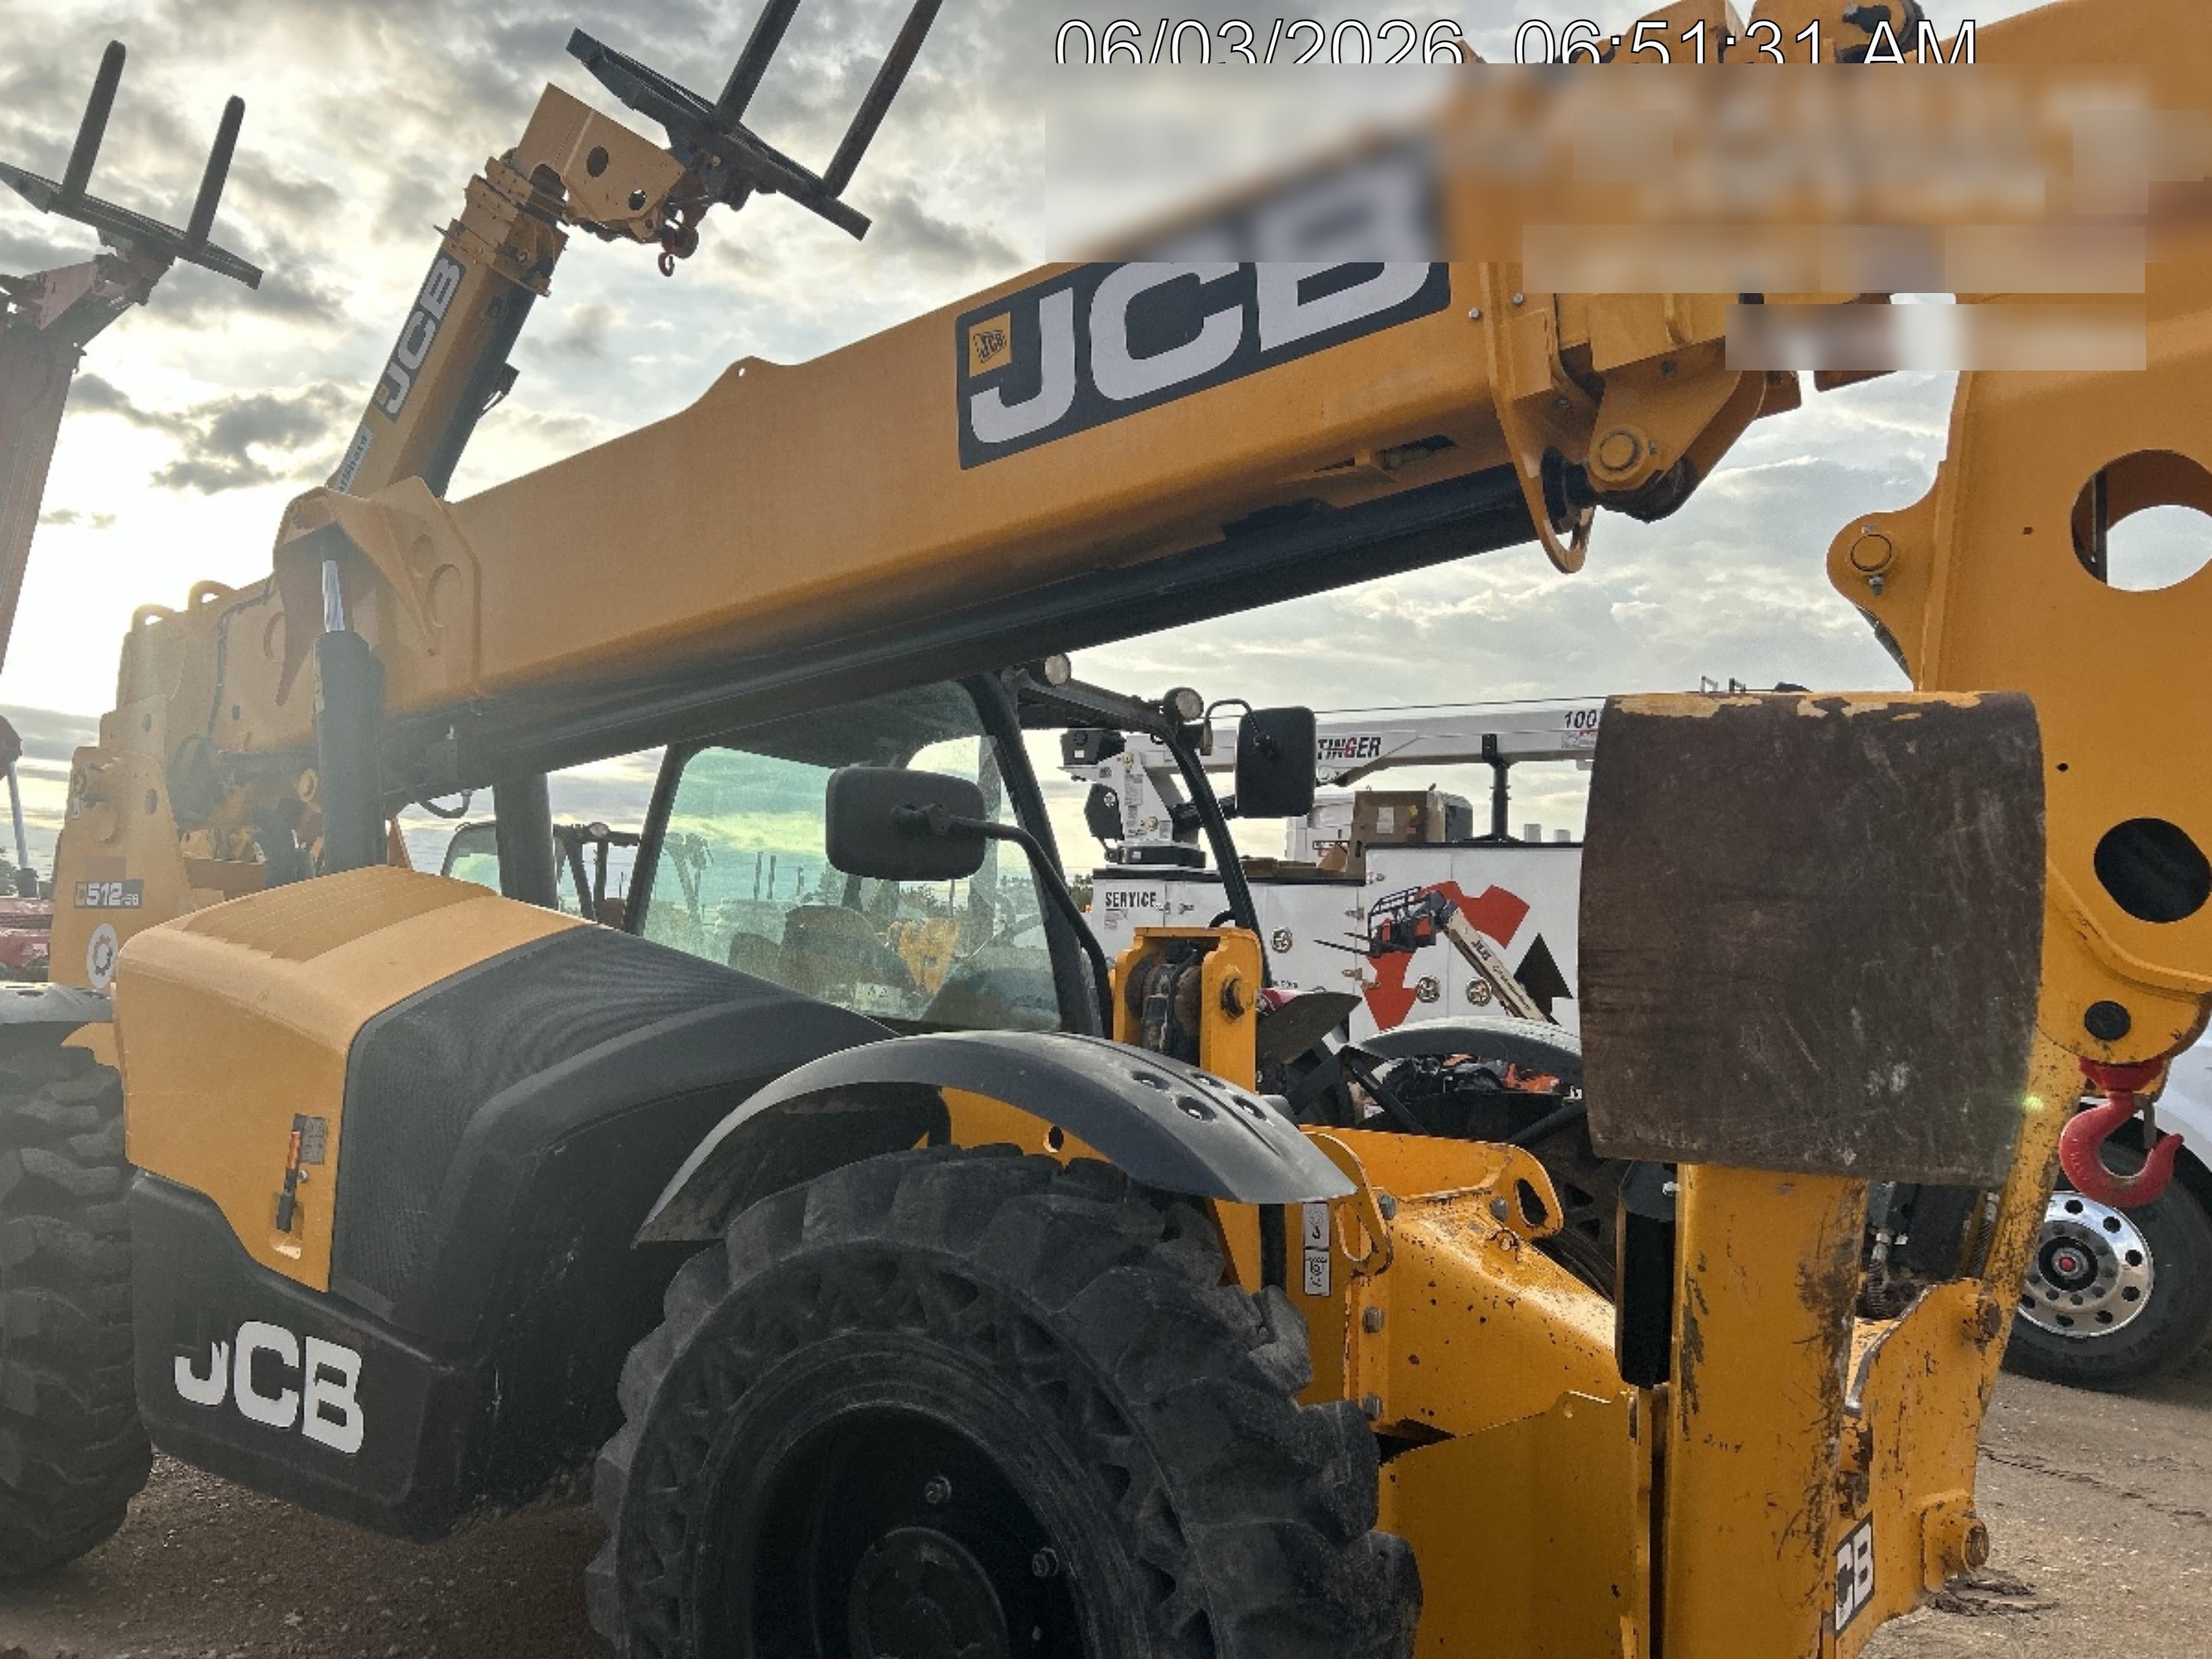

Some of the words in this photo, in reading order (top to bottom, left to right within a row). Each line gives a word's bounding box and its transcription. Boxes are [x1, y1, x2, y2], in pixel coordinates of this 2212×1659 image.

[386, 257, 460, 415] JCB
[979, 331, 1004, 359] JCB
[1105, 891, 1157, 908] SERVICE
[175, 1320, 365, 1454] JCB
